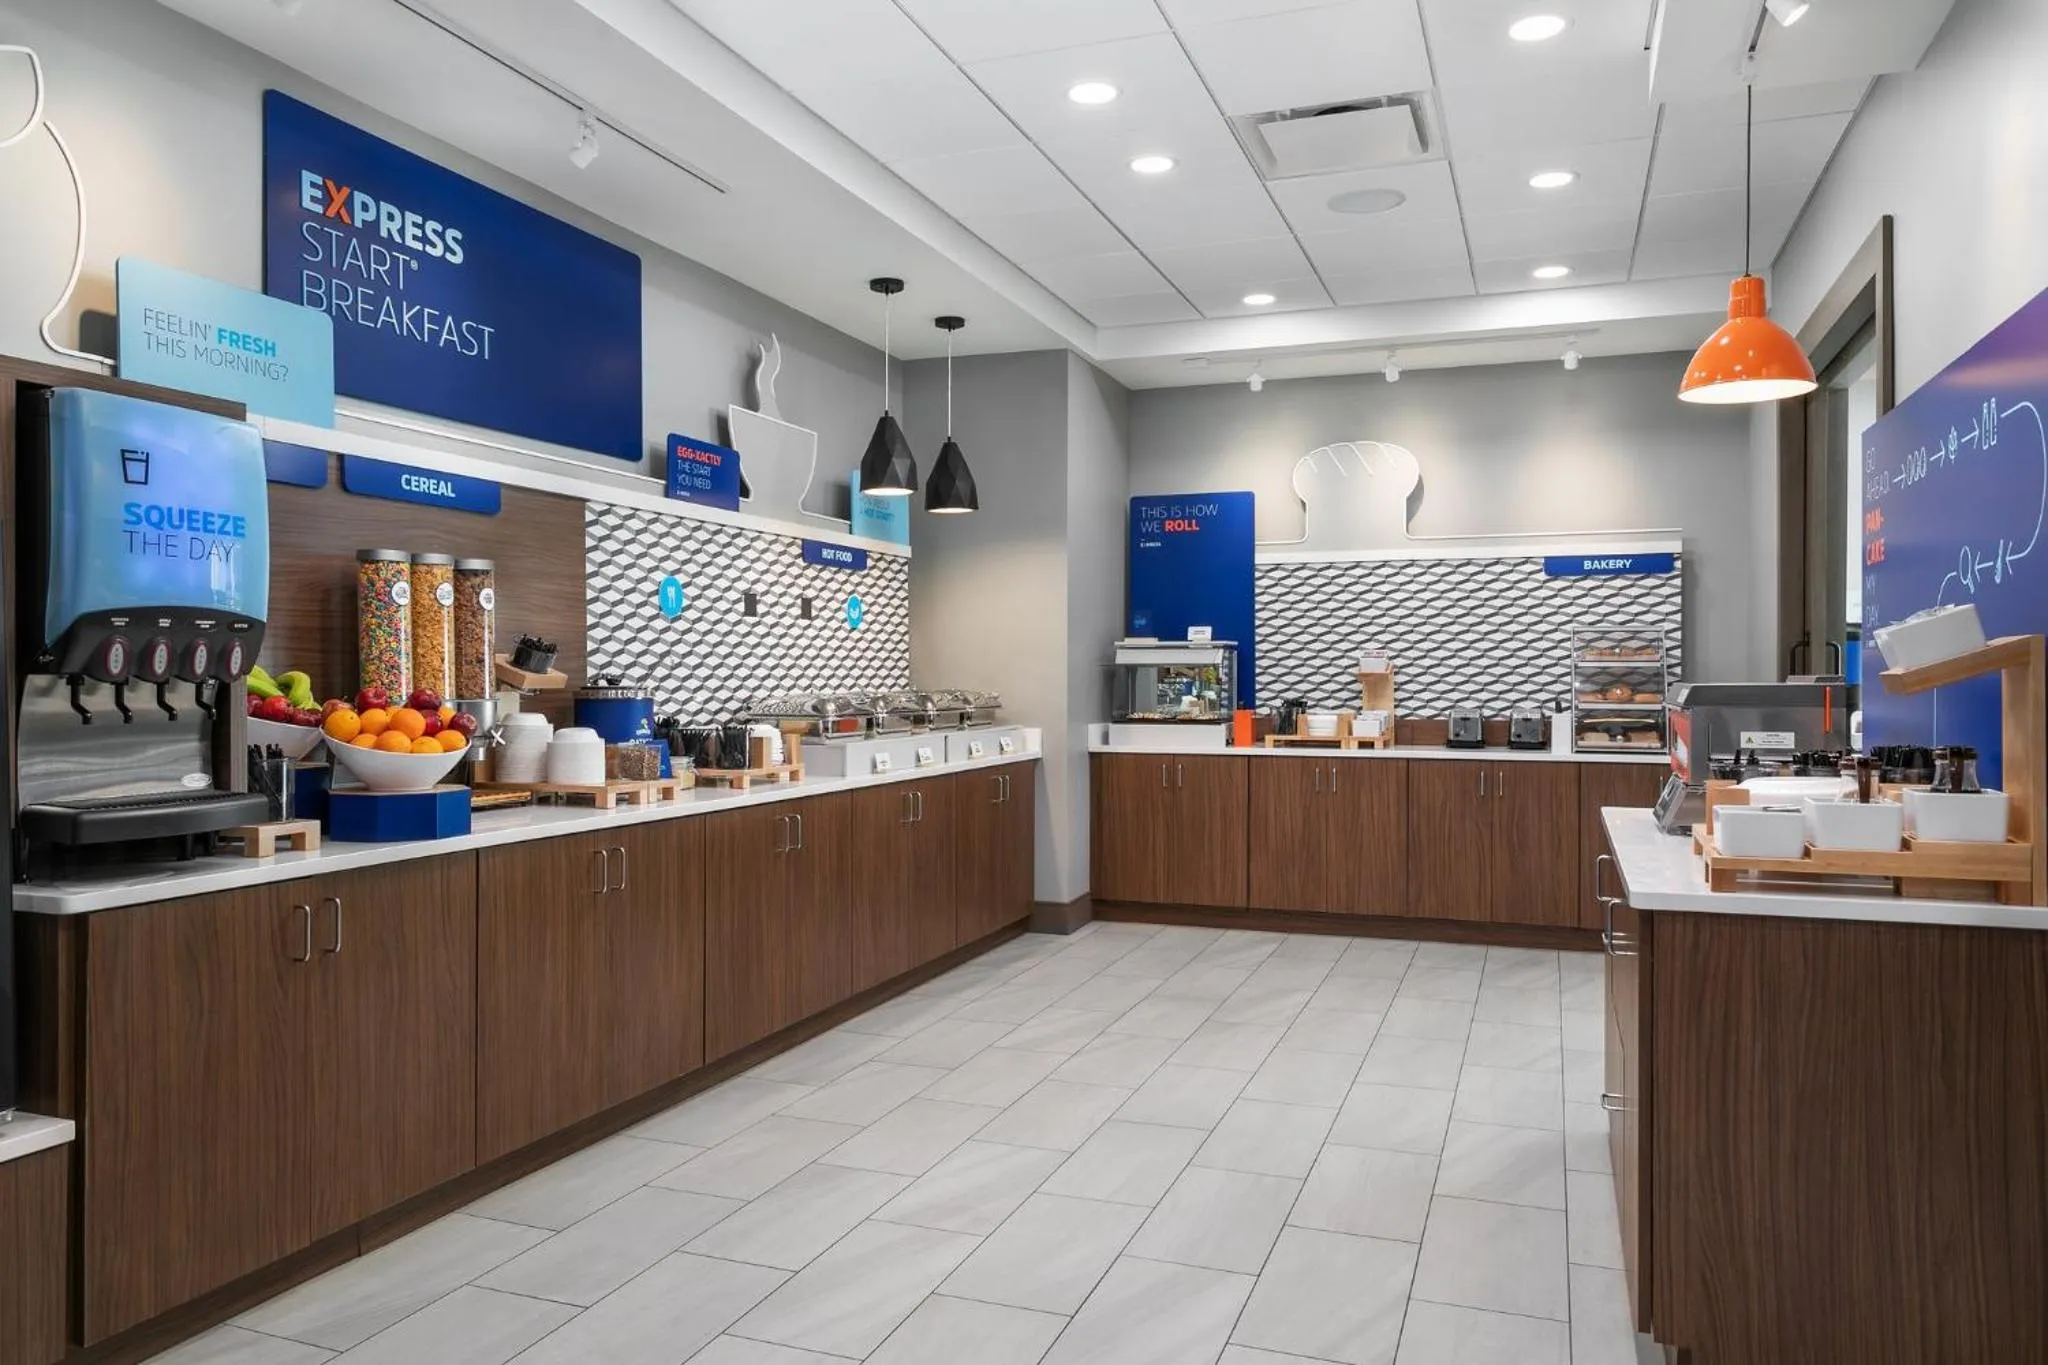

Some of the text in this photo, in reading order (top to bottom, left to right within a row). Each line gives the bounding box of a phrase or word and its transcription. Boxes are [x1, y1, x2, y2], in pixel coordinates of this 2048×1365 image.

[301, 169, 464, 265] EXPRESS
[302, 269, 495, 359] BREAKFAST
[144, 308, 277, 358] FEELIN' FRESH
[144, 331, 289, 382] THIS MORNING?
[677, 446, 722, 467] EGG-XACTLY
[677, 459, 691, 473] THE
[401, 474, 456, 498] CEREAL
[677, 473, 712, 490] YOU NEED
[123, 502, 247, 539] SQUEEZE
[1141, 503, 1219, 519] THIS IS HOW
[1141, 519, 1200, 533] WE ROLL
[123, 530, 237, 563] THE DAY
[821, 548, 853, 563] HOT FOOD
[1583, 559, 1633, 570] BAKERY
